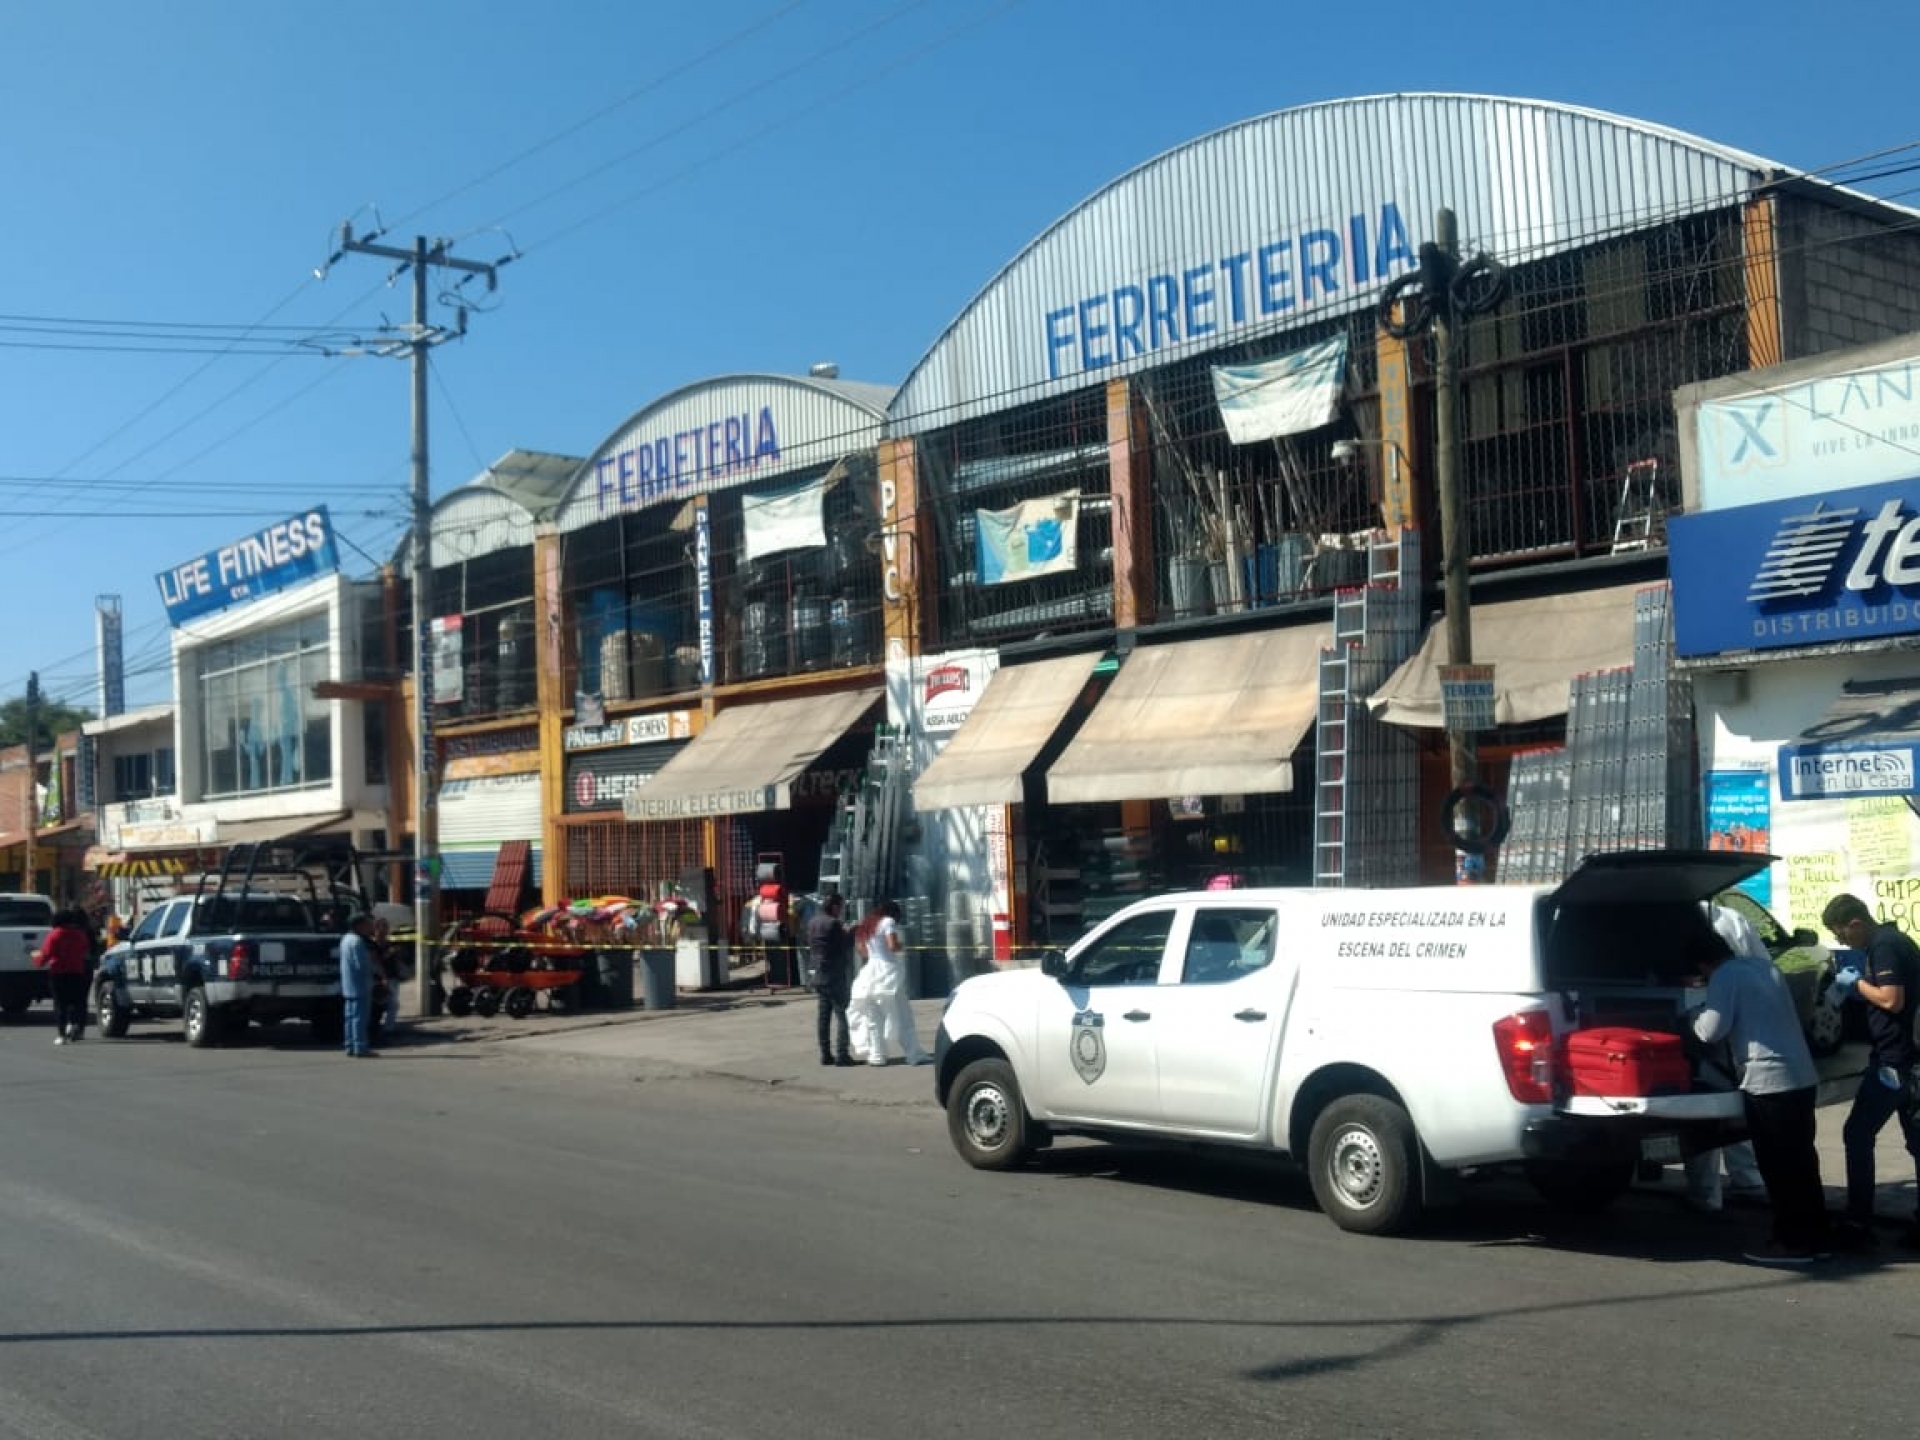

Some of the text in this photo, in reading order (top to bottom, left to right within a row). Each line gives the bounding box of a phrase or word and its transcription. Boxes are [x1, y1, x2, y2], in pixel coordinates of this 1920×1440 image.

[1046, 202, 1416, 380] FERRETERIA
[596, 405, 781, 512] FERRETERIA
[1813, 438, 1846, 456] VIVE
[881, 479, 900, 599] PVC
[1846, 499, 1920, 590] te
[160, 512, 325, 606] LIFE FITNESS
[695, 509, 711, 613] PANEL
[631, 718, 667, 738] SIEMENS
[1795, 754, 1885, 776] Internet
[597, 773, 653, 800] HER
[1816, 773, 1911, 790] en tu casa
[625, 796, 685, 817] MATERIAL
[1321, 912, 1506, 927] UNIDAD ESPECIALIZADA EN LA
[1338, 942, 1468, 958] ESCENA DEL CRIMEN
